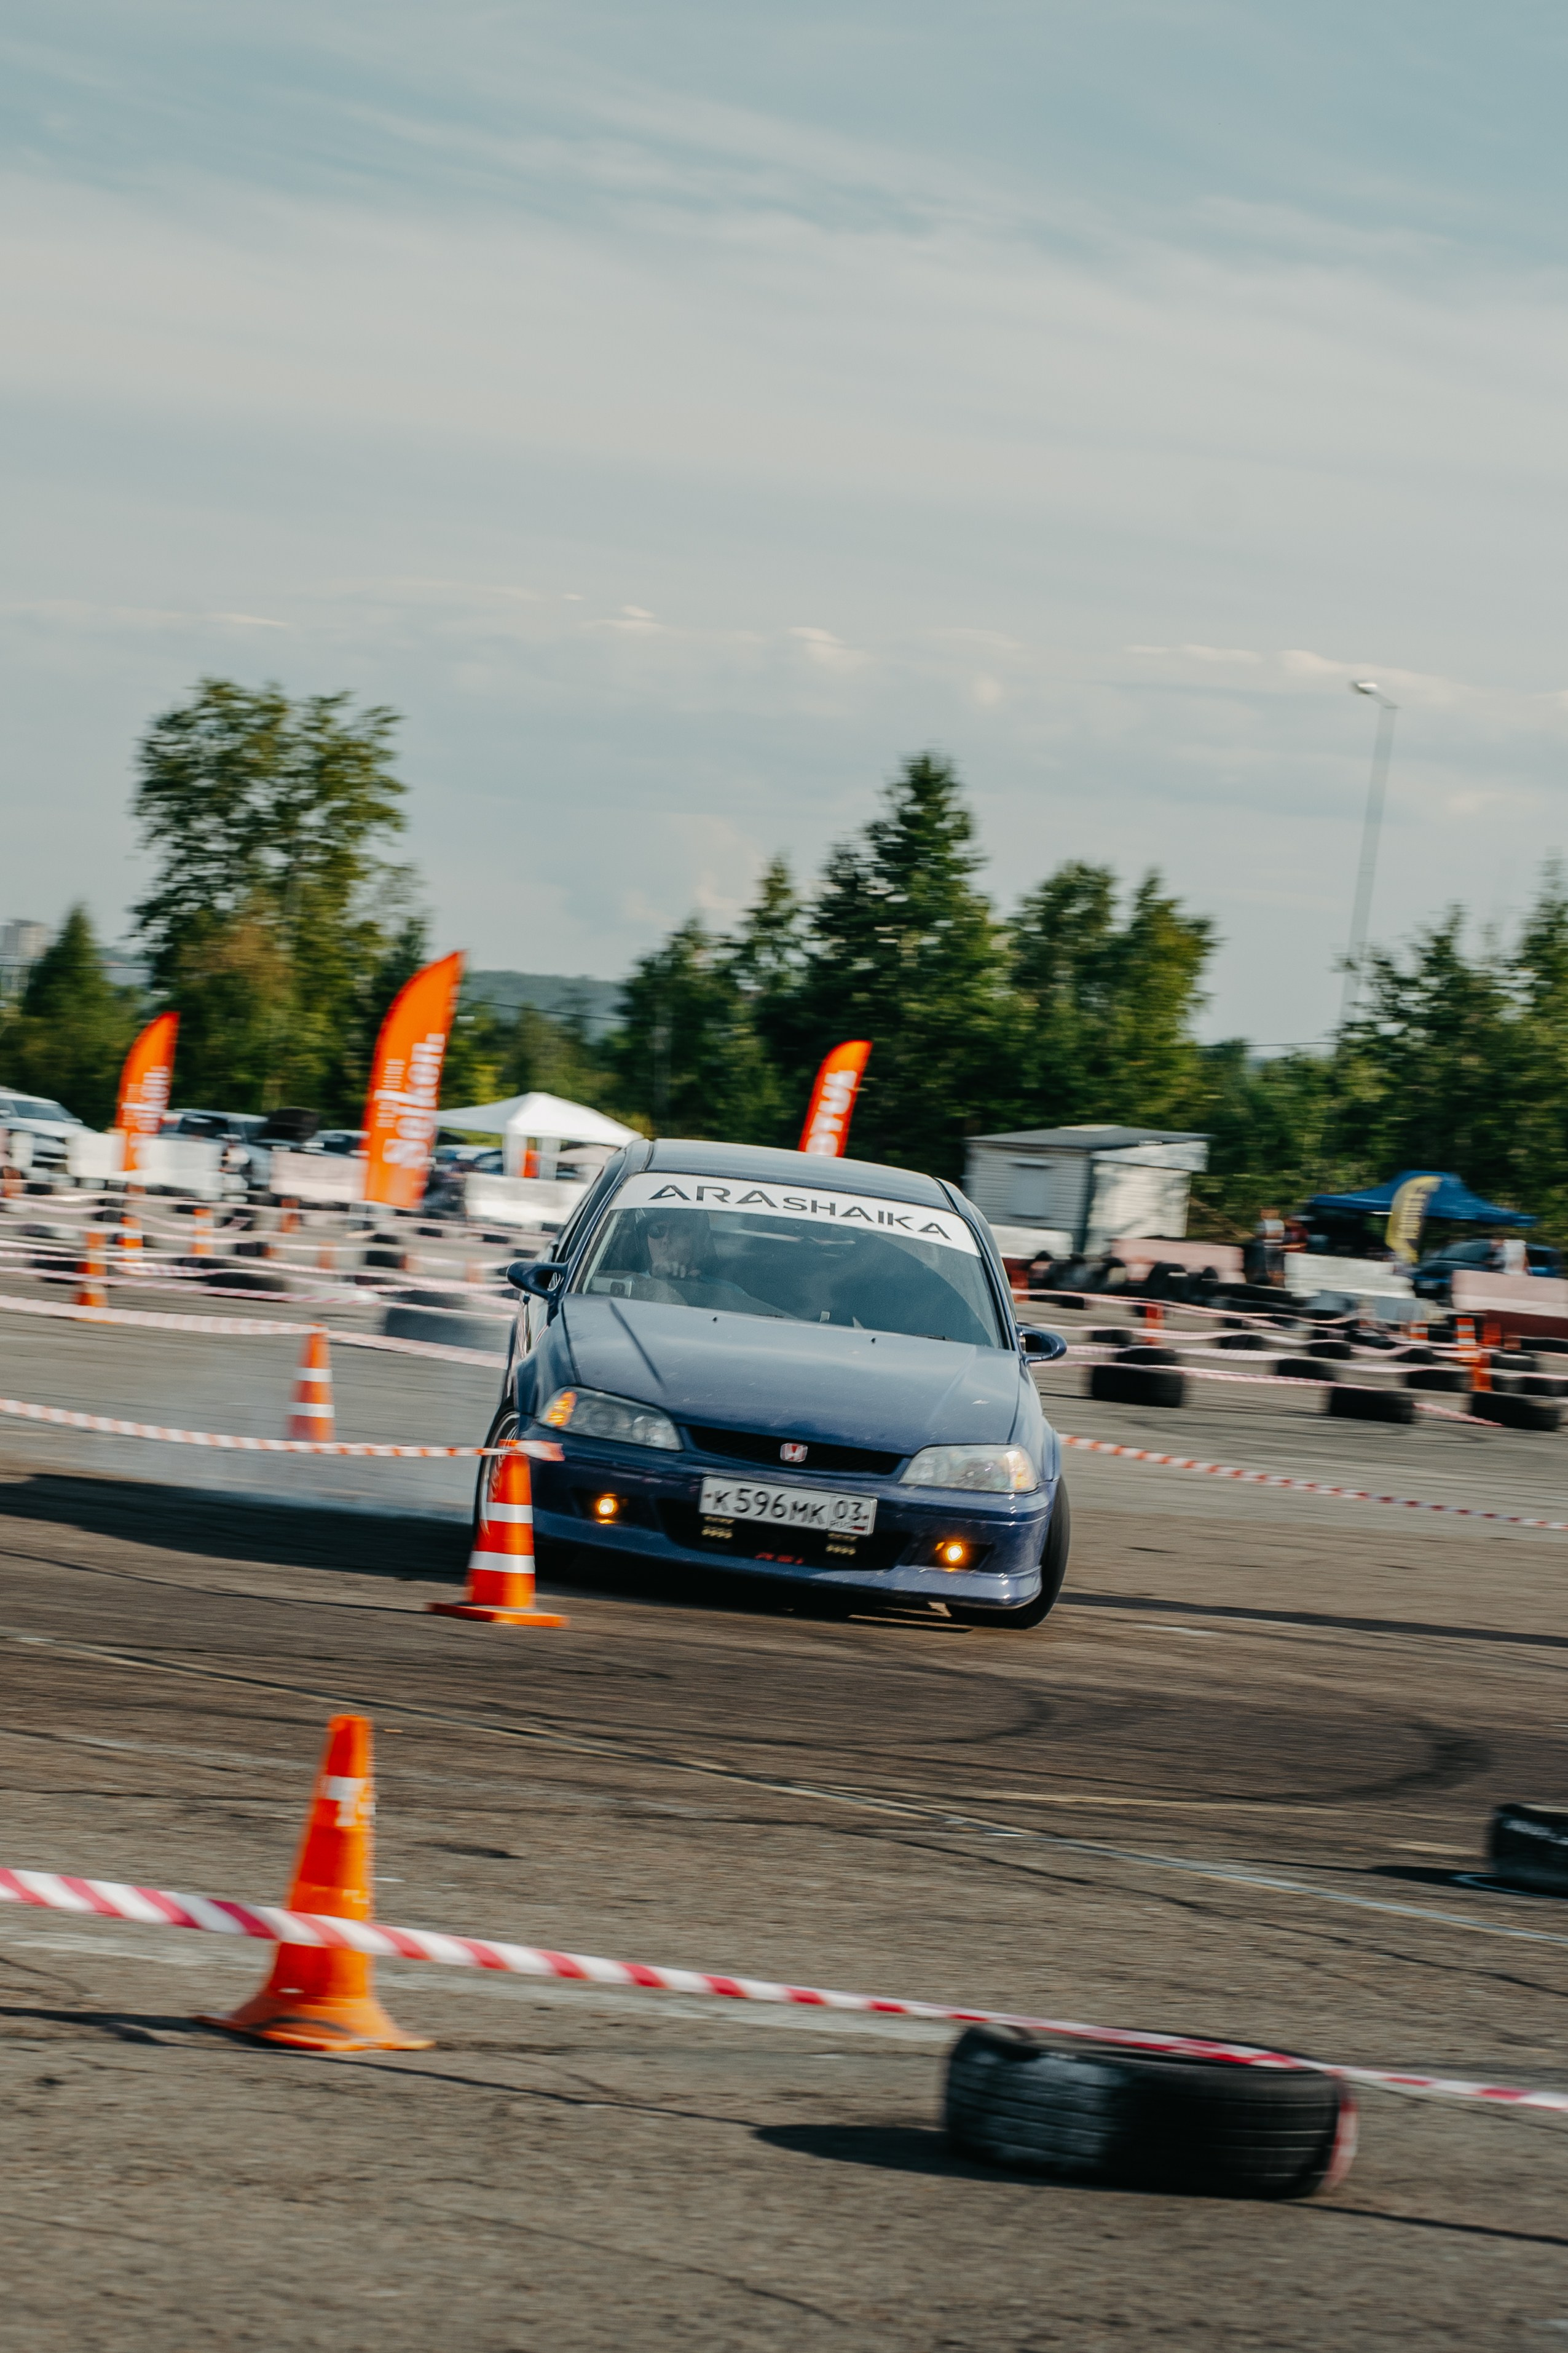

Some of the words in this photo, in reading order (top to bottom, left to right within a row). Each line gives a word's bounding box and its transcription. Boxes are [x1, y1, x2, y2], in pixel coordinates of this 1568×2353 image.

[806, 1070, 857, 1157] OTUL
[648, 1184, 953, 1241] ARASHAIKA
[833, 1500, 862, 1521] 03
